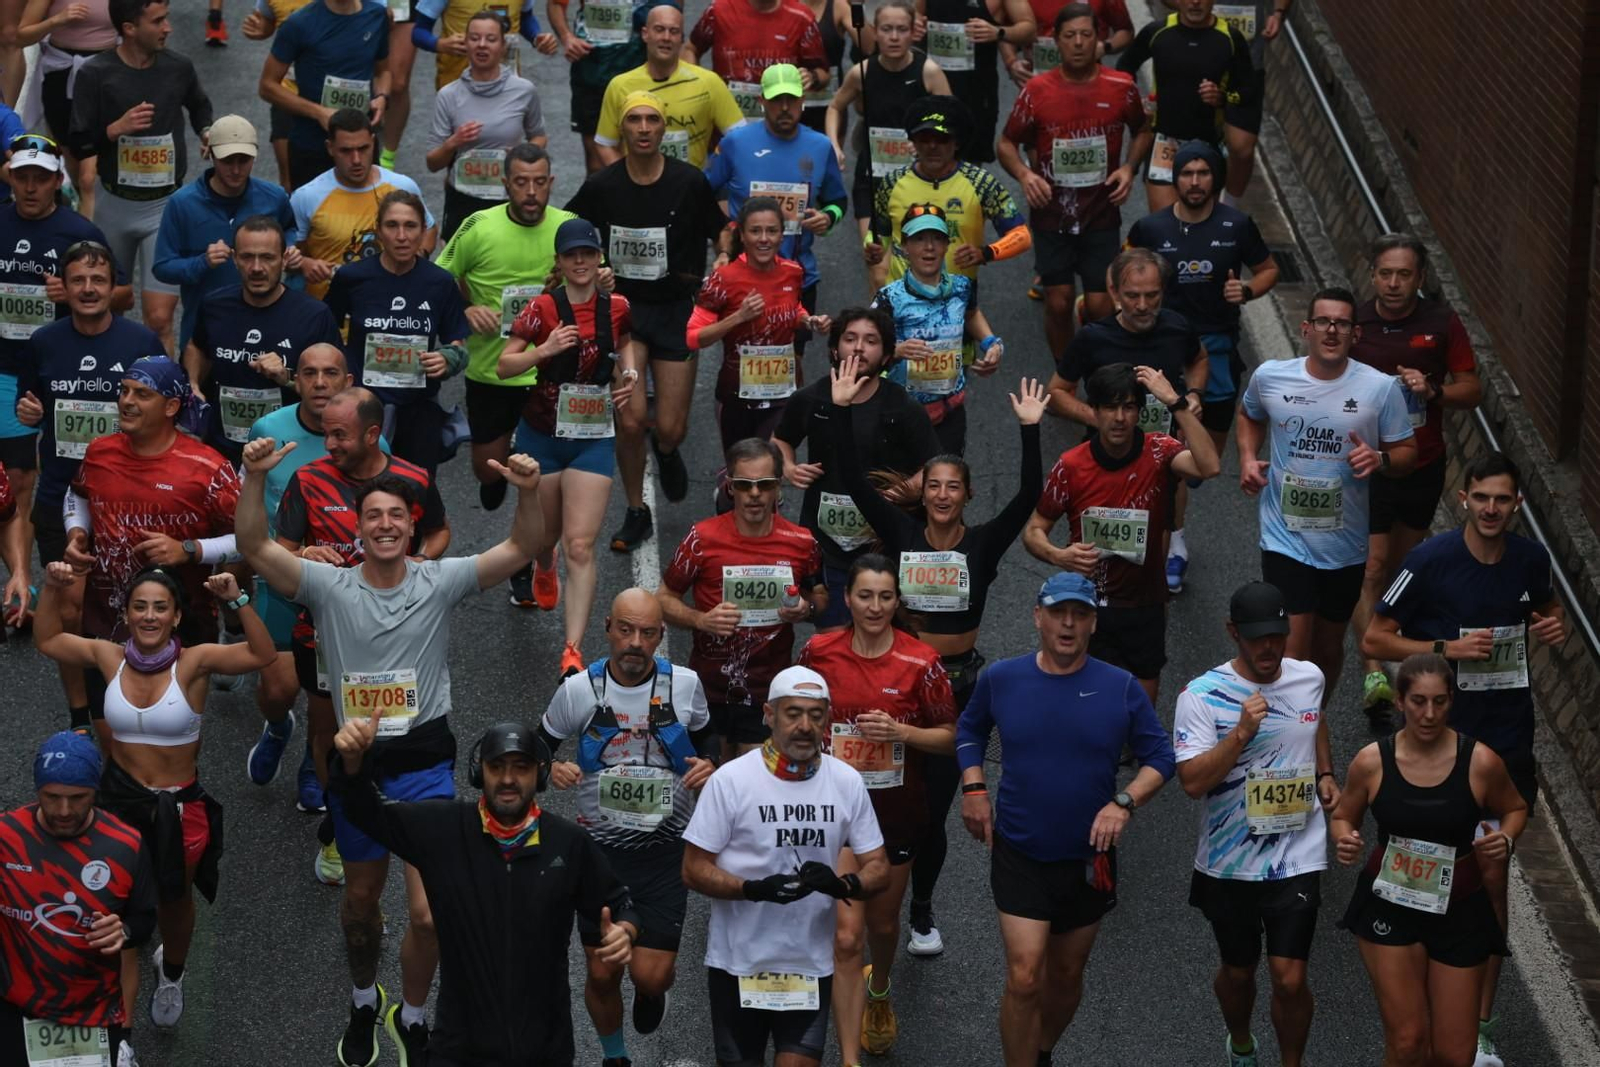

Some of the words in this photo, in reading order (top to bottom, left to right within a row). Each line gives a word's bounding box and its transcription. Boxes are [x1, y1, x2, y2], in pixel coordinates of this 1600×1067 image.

[589, 7, 622, 22] 7396
[331, 90, 364, 108] 9460
[121, 149, 168, 165] 14585
[1059, 149, 1094, 167] 9232
[464, 161, 500, 177] 9410
[614, 240, 657, 257] 17325
[364, 315, 421, 332] sayhello
[375, 347, 412, 365] 9711
[914, 352, 954, 373] 11251
[746, 358, 789, 376] 11173
[51, 377, 111, 395] sayhello
[229, 400, 267, 419] 9257
[568, 397, 604, 415] 9986
[65, 414, 106, 434] 9710
[1297, 438, 1341, 454] DESTINO
[1289, 489, 1331, 509] 9262
[1091, 520, 1132, 541] 7449
[905, 566, 959, 586] 10032
[734, 580, 778, 600] 8420
[348, 687, 405, 709] 13708
[843, 740, 886, 761] 5721
[610, 780, 655, 804] 6841
[1251, 781, 1305, 806] 14374
[758, 804, 777, 823] VA
[783, 803, 816, 823] POR
[820, 804, 835, 823] TI
[776, 828, 827, 848] PAPA
[1390, 852, 1439, 881] 9167
[39, 1025, 92, 1048] 9210
